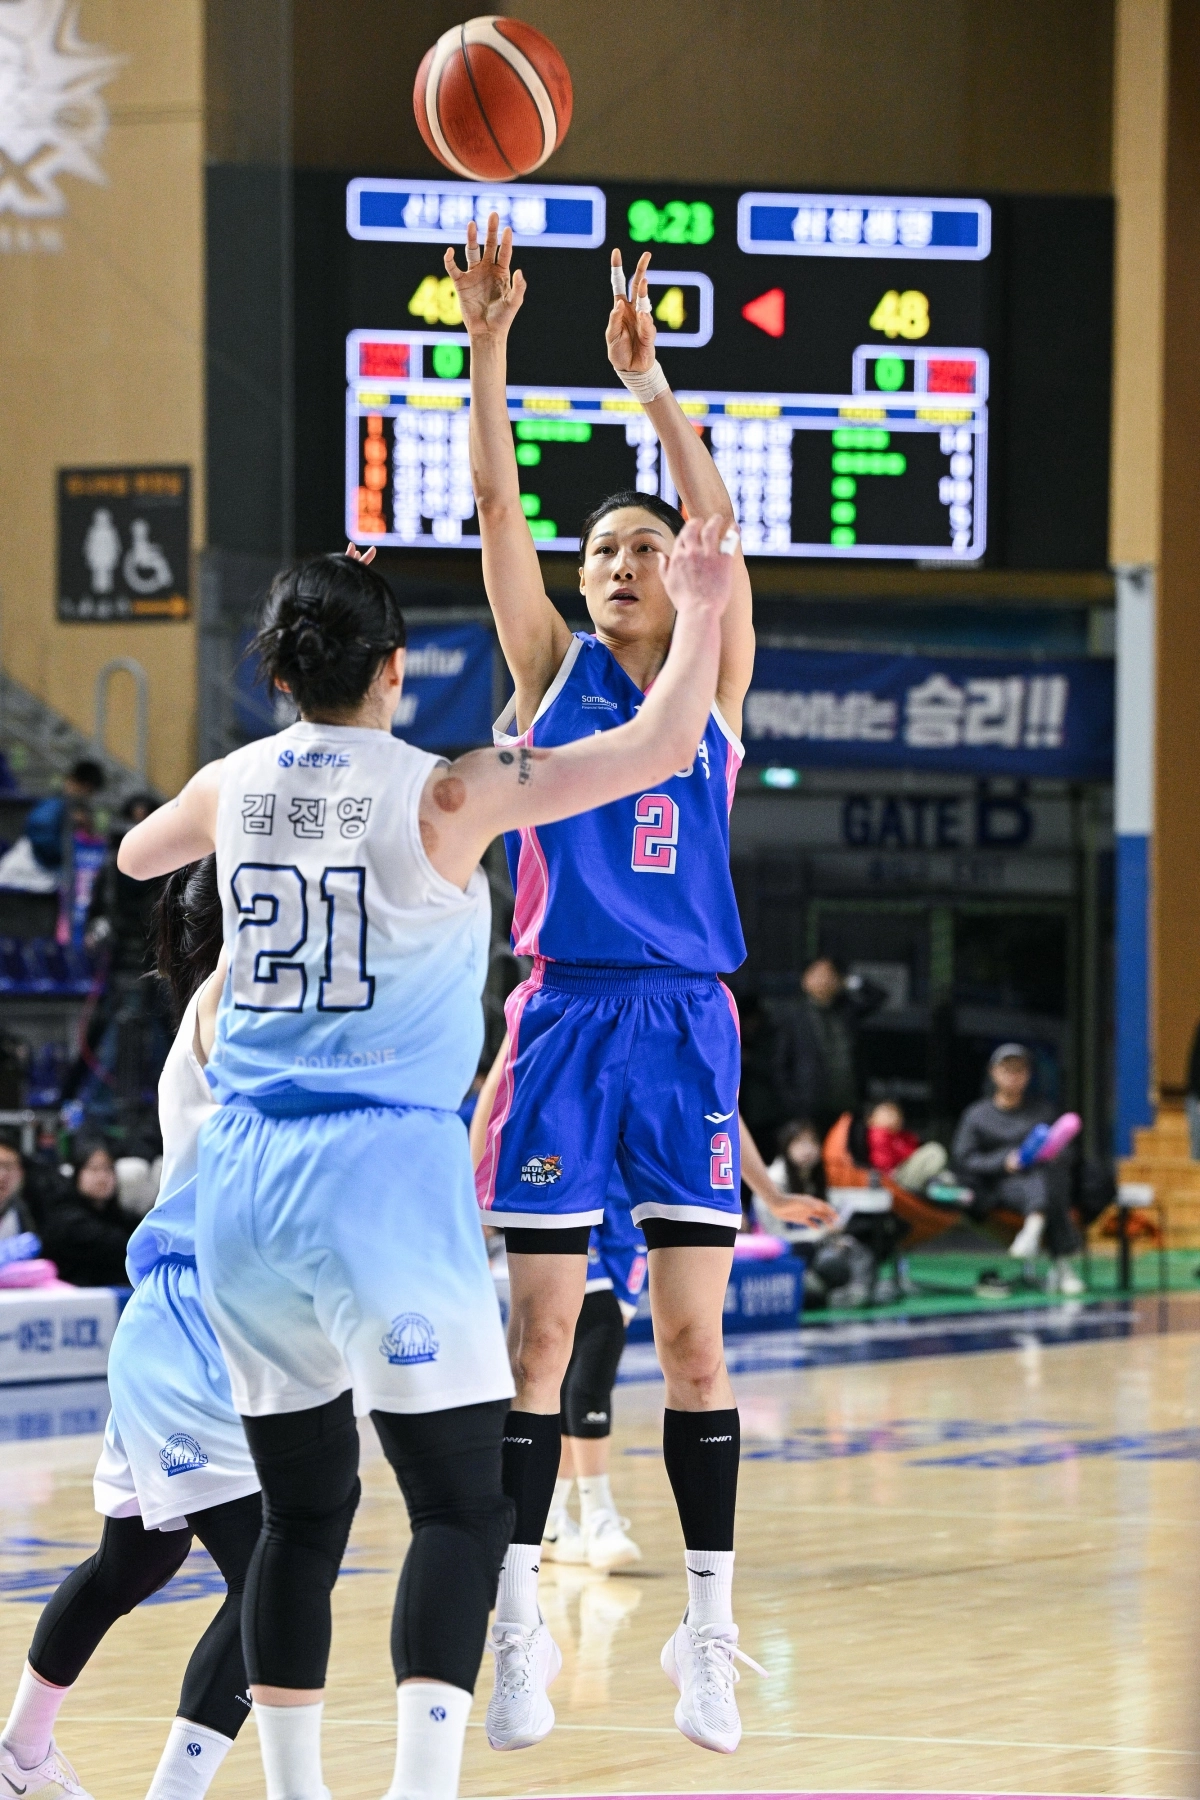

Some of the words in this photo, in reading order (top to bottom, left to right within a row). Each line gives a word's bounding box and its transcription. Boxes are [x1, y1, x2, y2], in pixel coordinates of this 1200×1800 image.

[628, 200, 714, 244] 9:23
[656, 287, 686, 329] 4
[869, 289, 930, 339] 48
[433, 340, 463, 378] 0
[875, 352, 905, 391] 0
[581, 694, 618, 709] Samsung
[904, 671, 1069, 749] 승리!!
[297, 752, 351, 768] 신한카드
[631, 794, 679, 874] 2
[843, 797, 961, 848] GATE
[976, 776, 1034, 848] B
[231, 863, 375, 1012] 21
[521, 1165, 543, 1173] BLUE
[710, 1133, 735, 1189] 2
